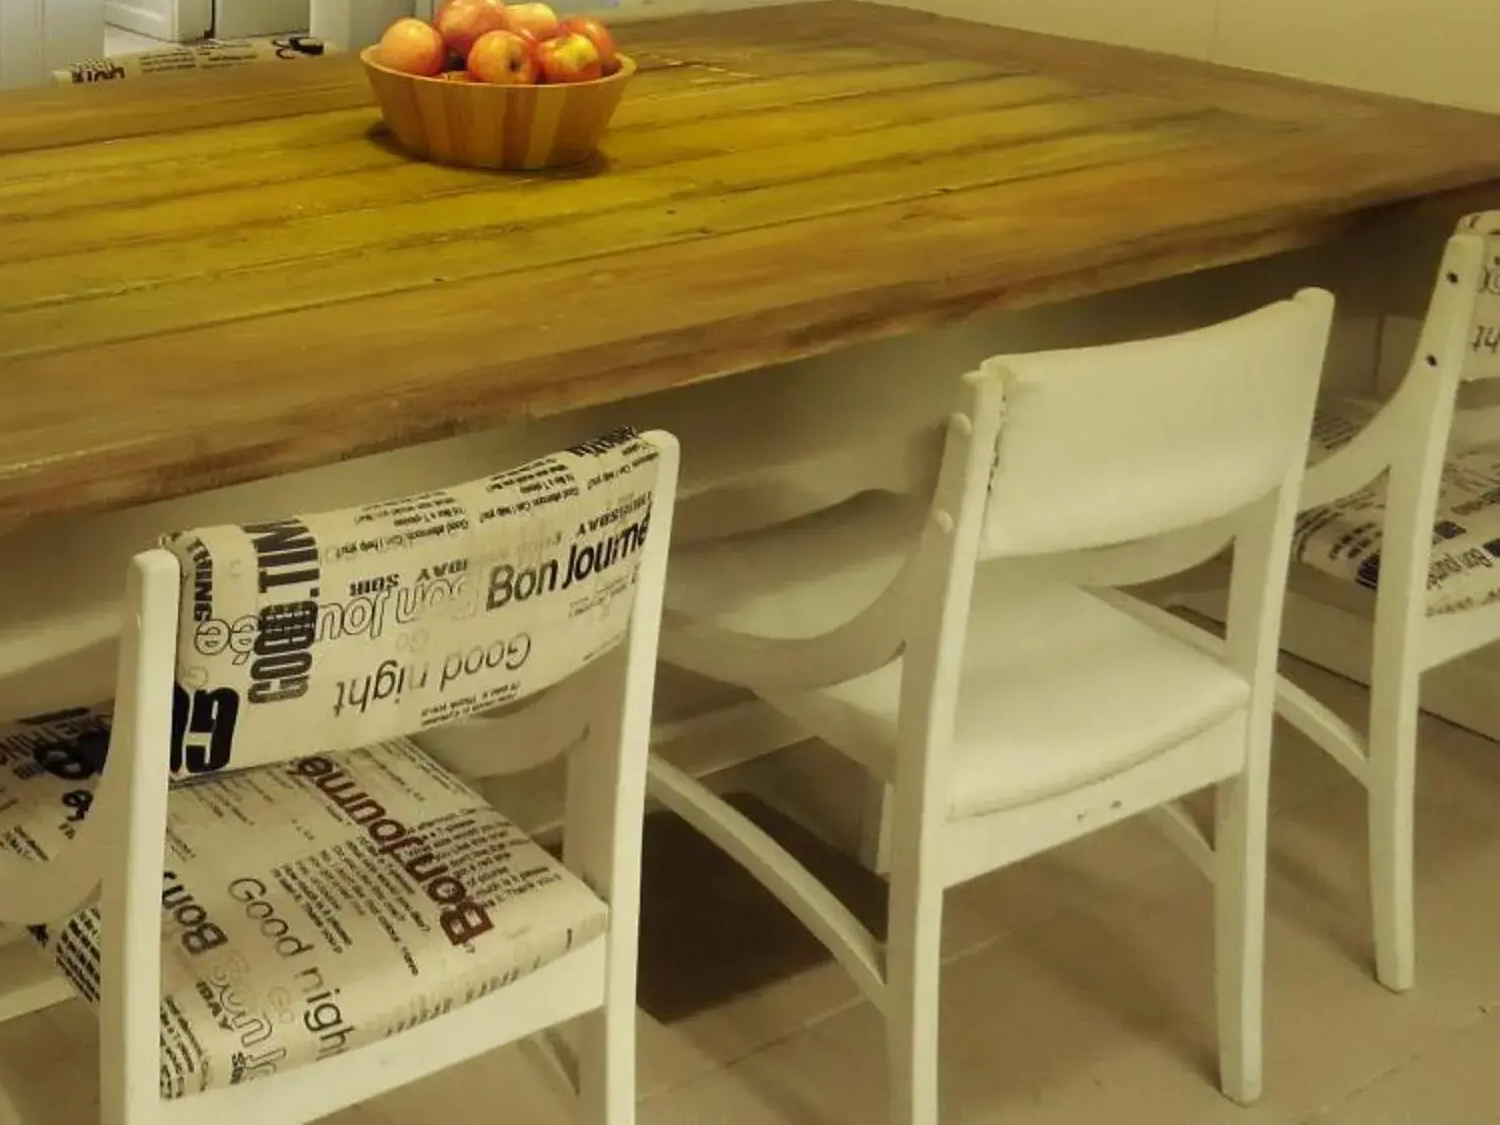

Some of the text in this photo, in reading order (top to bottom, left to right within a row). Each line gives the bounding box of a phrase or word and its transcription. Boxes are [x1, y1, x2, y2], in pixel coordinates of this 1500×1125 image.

[485, 558, 559, 612] Bon
[335, 659, 427, 717] night
[438, 632, 532, 692] Good
[227, 877, 314, 958] Good
[407, 853, 495, 946] Bon
